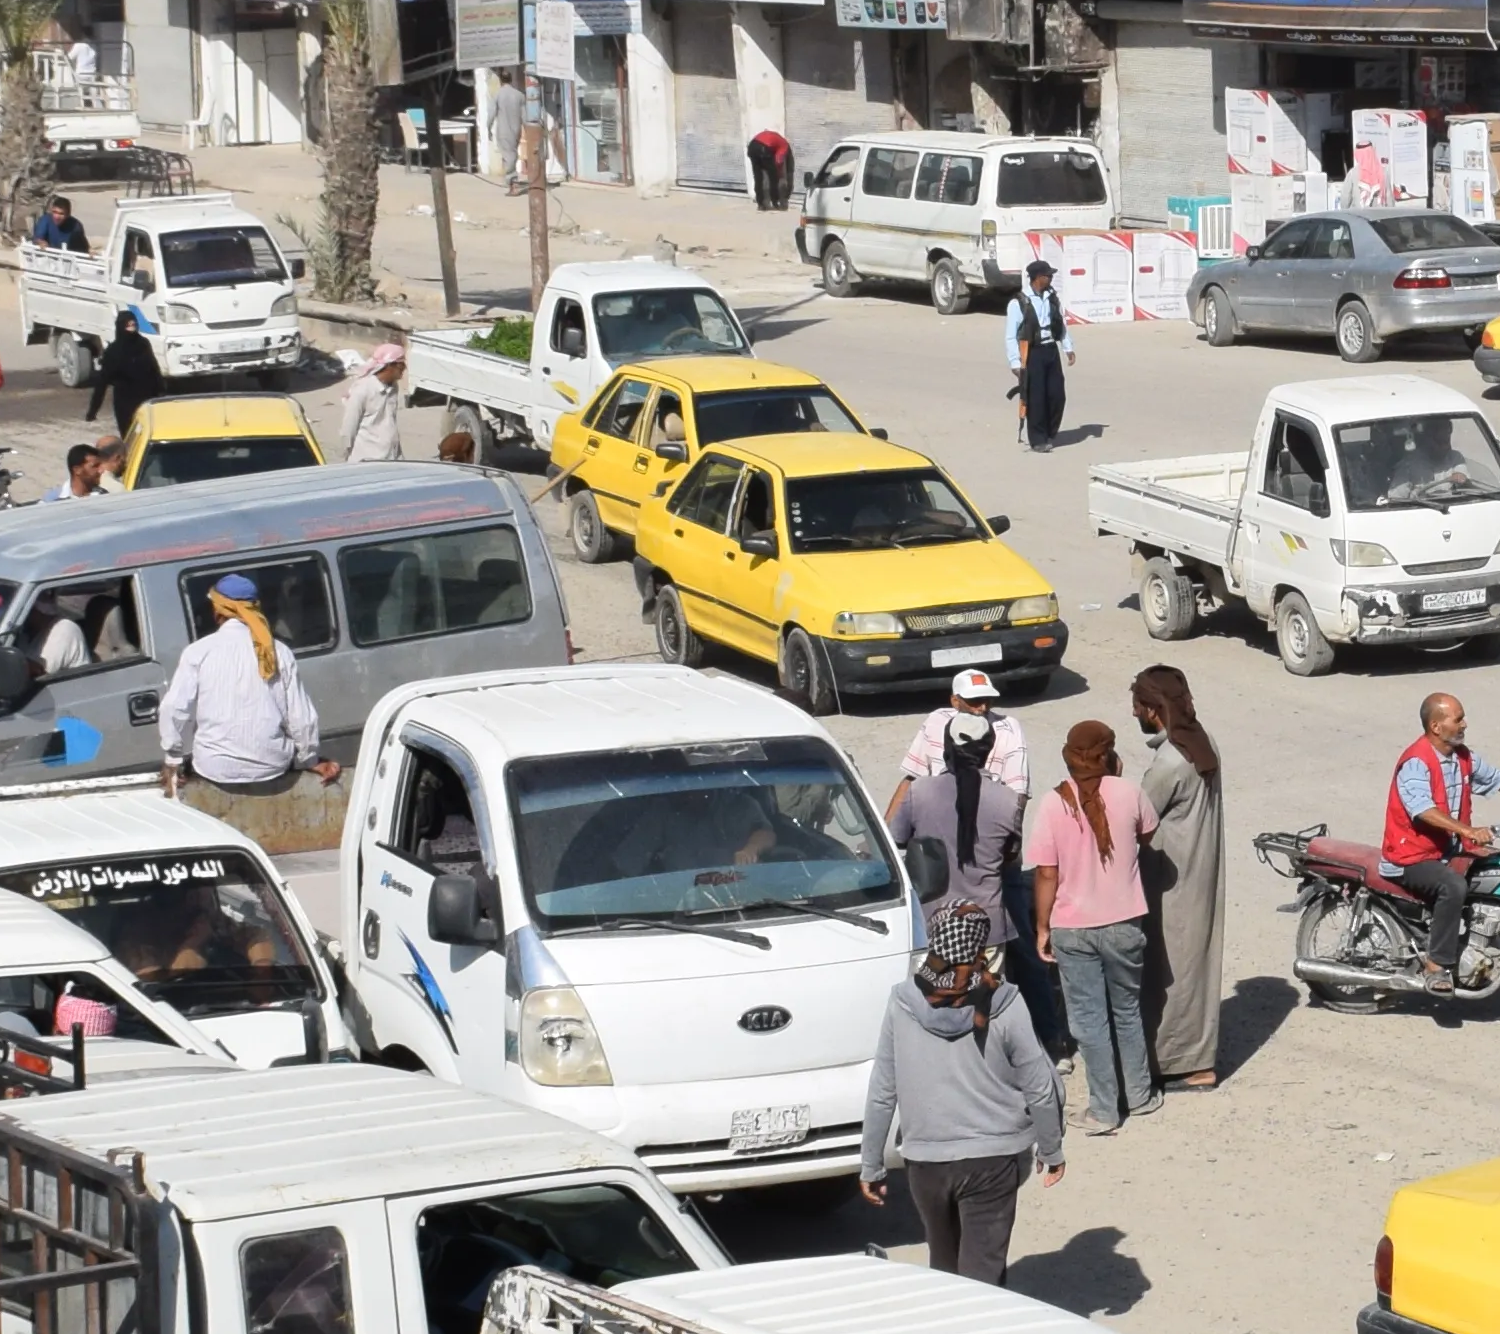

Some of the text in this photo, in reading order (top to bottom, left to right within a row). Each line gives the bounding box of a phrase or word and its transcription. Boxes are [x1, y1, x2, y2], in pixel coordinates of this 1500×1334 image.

[31, 859, 226, 898] الله نور السموات والارض
[746, 1010, 785, 1030] KIA
